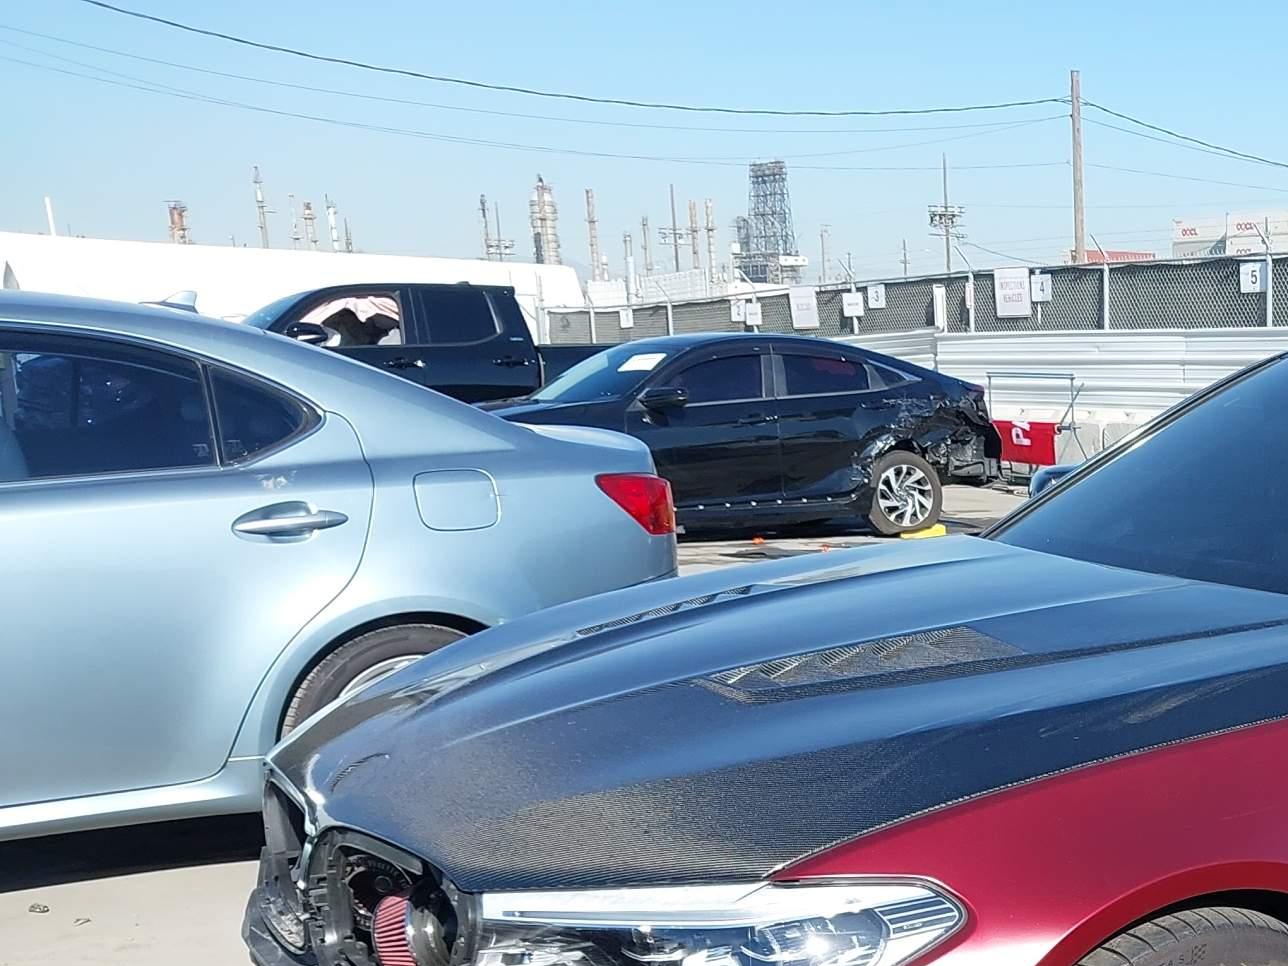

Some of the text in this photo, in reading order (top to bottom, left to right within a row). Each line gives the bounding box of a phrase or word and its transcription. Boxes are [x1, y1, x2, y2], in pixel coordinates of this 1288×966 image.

[1250, 269, 1258, 285] 5
[1039, 280, 1045, 295] 4
[872, 289, 881, 303] 3
